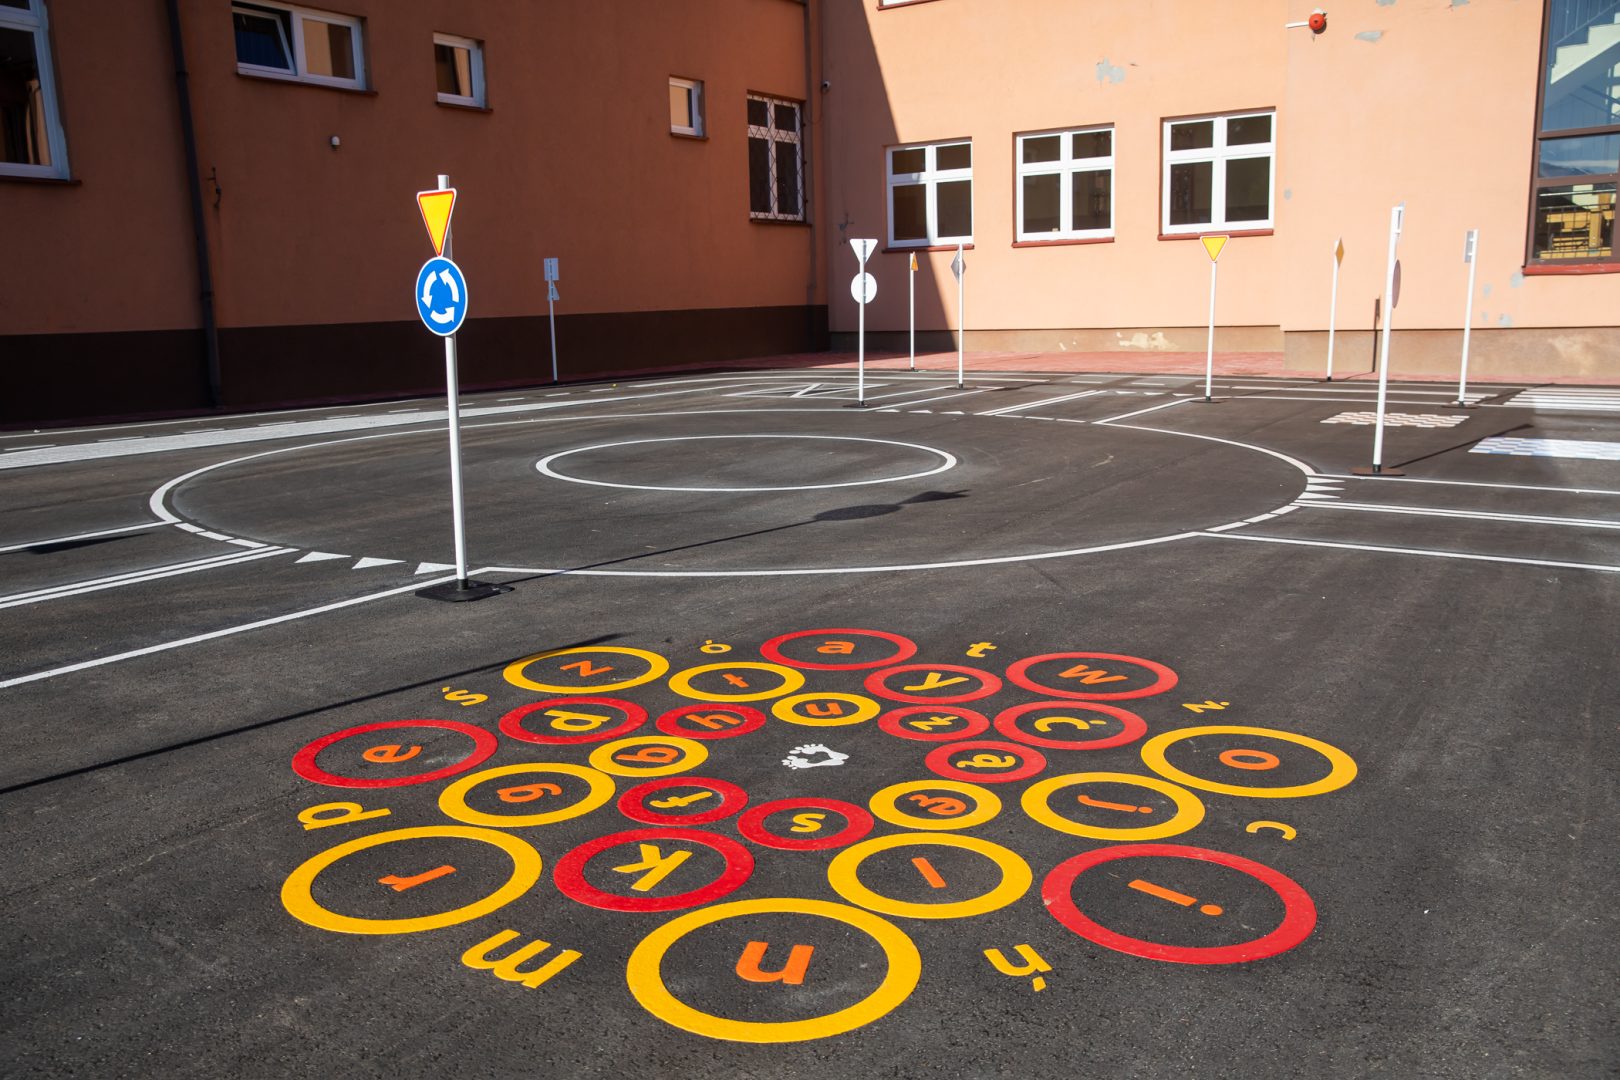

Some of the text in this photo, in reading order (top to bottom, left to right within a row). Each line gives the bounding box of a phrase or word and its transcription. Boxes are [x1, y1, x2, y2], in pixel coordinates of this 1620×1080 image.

[815, 640, 856, 655] a
[965, 641, 997, 658] t
[902, 671, 969, 692] y
[1056, 663, 1129, 685] w
[804, 701, 844, 717] u
[361, 743, 423, 764] e
[1218, 748, 1281, 771] o
[789, 812, 827, 834] s
[611, 843, 694, 893] k
